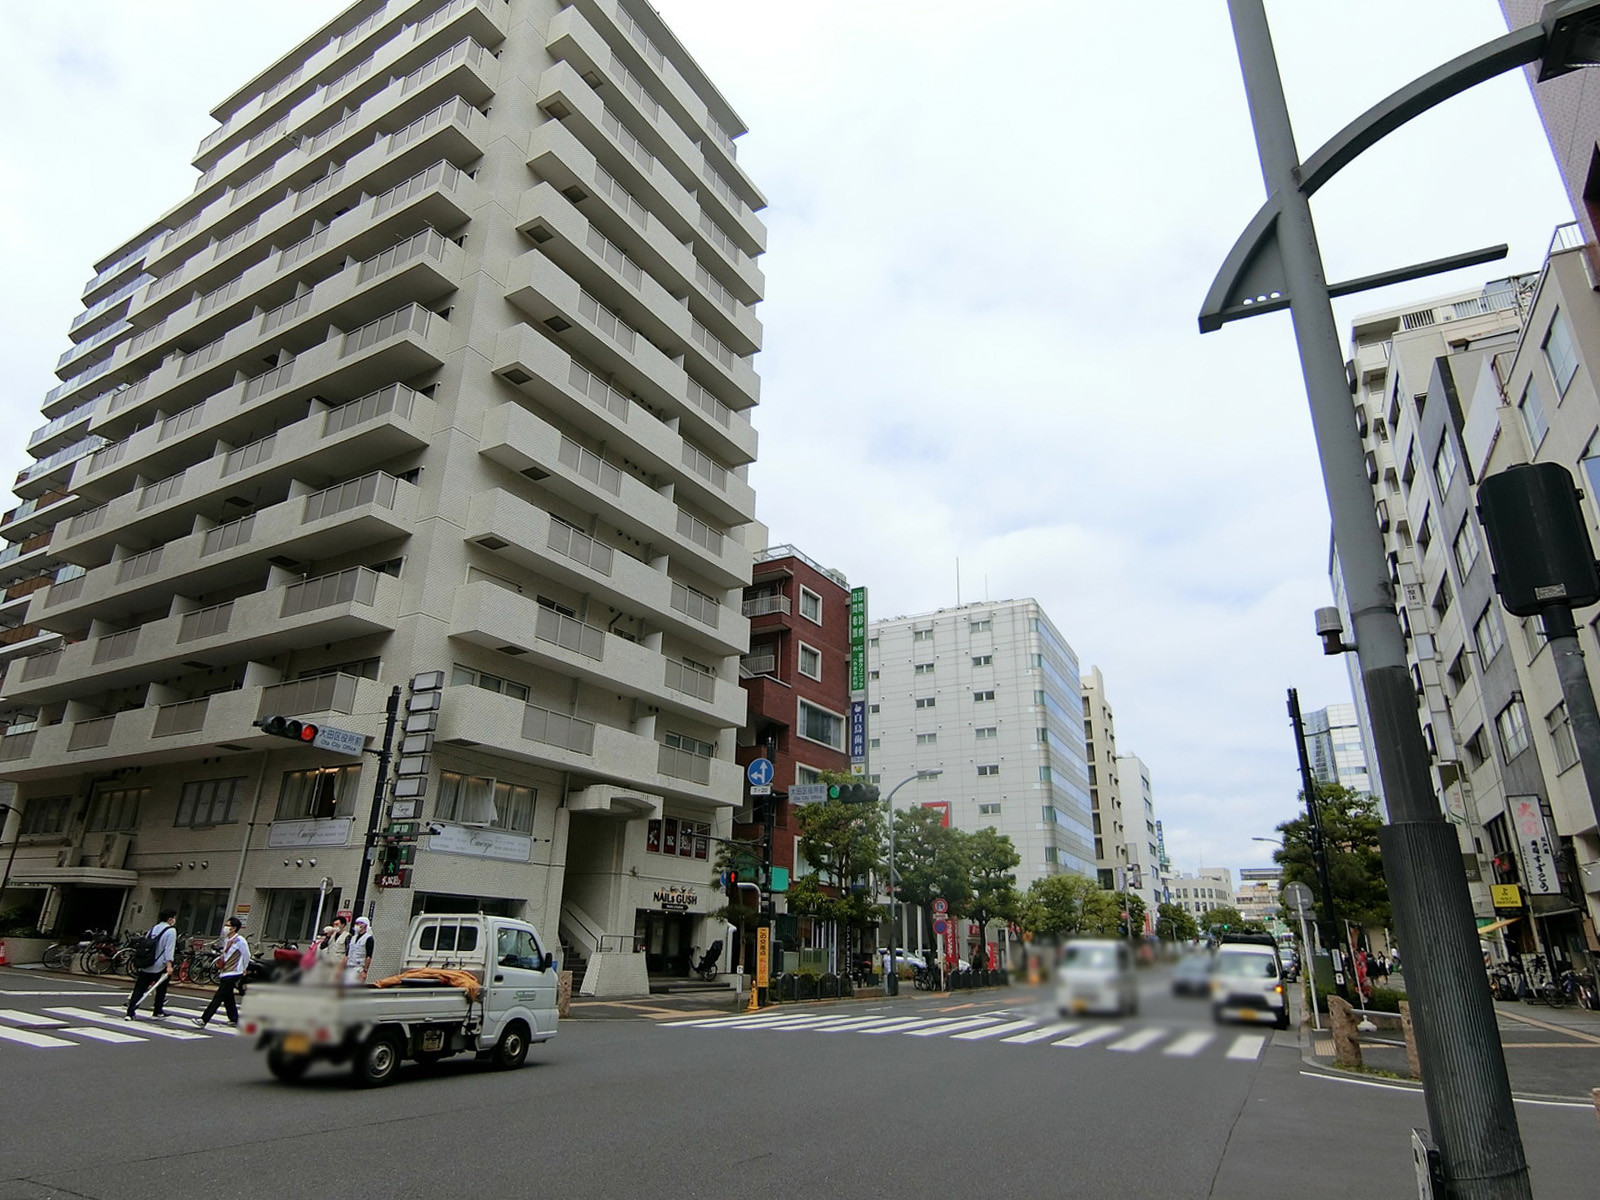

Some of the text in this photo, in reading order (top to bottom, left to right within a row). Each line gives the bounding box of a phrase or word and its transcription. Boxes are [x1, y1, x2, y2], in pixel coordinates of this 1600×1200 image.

[319, 729, 362, 746] 大田区役所前
[854, 713, 863, 756] 白鳥歯科
[790, 785, 826, 796] 大田区役所前
[675, 894, 698, 905] GUSH
